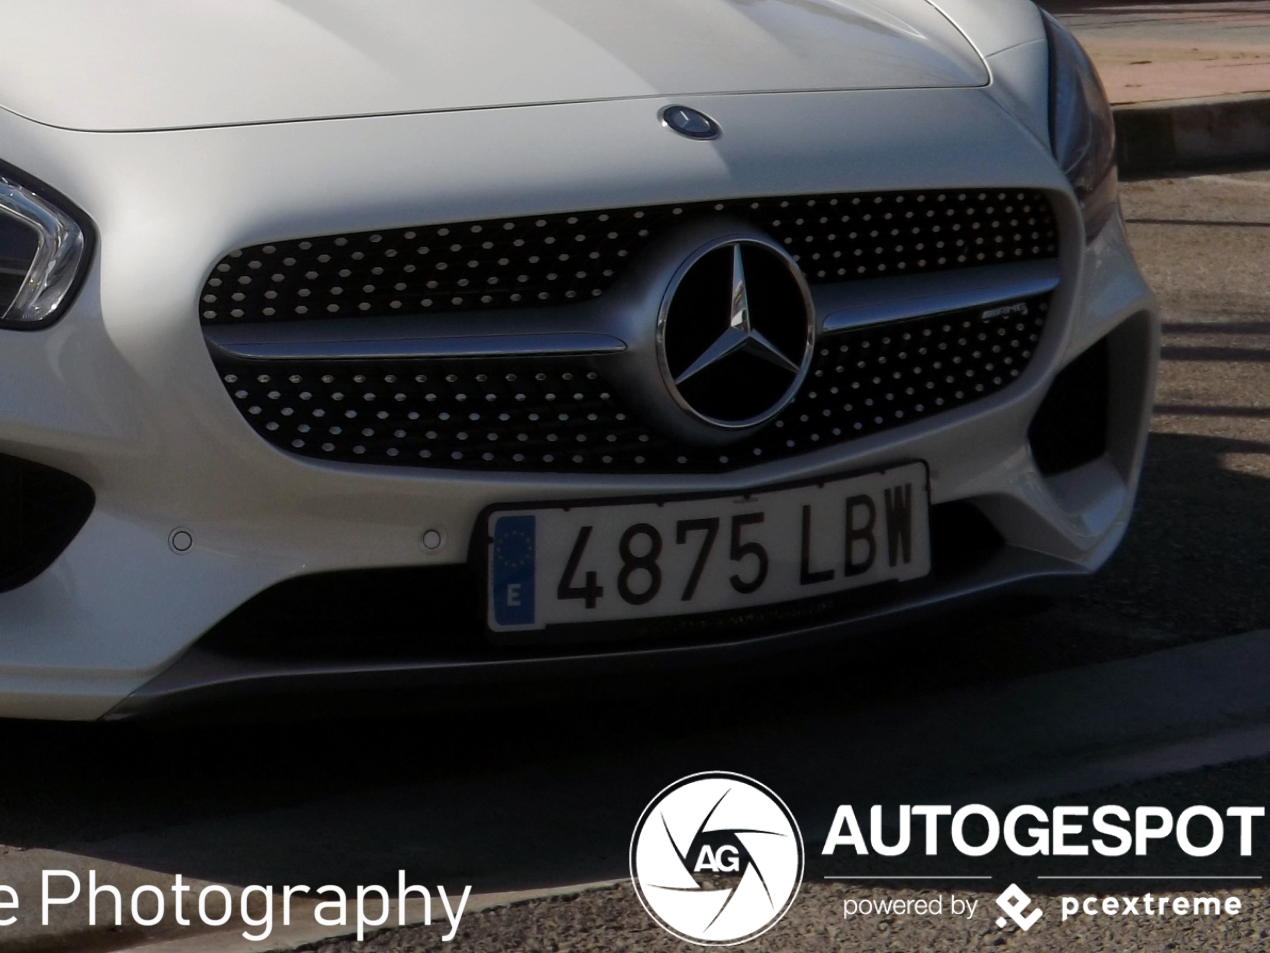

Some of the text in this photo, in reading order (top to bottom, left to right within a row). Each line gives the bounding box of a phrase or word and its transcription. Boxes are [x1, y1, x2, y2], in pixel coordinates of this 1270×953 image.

[556, 484, 913, 610] 4875 LBW
[506, 582, 522, 607] E
